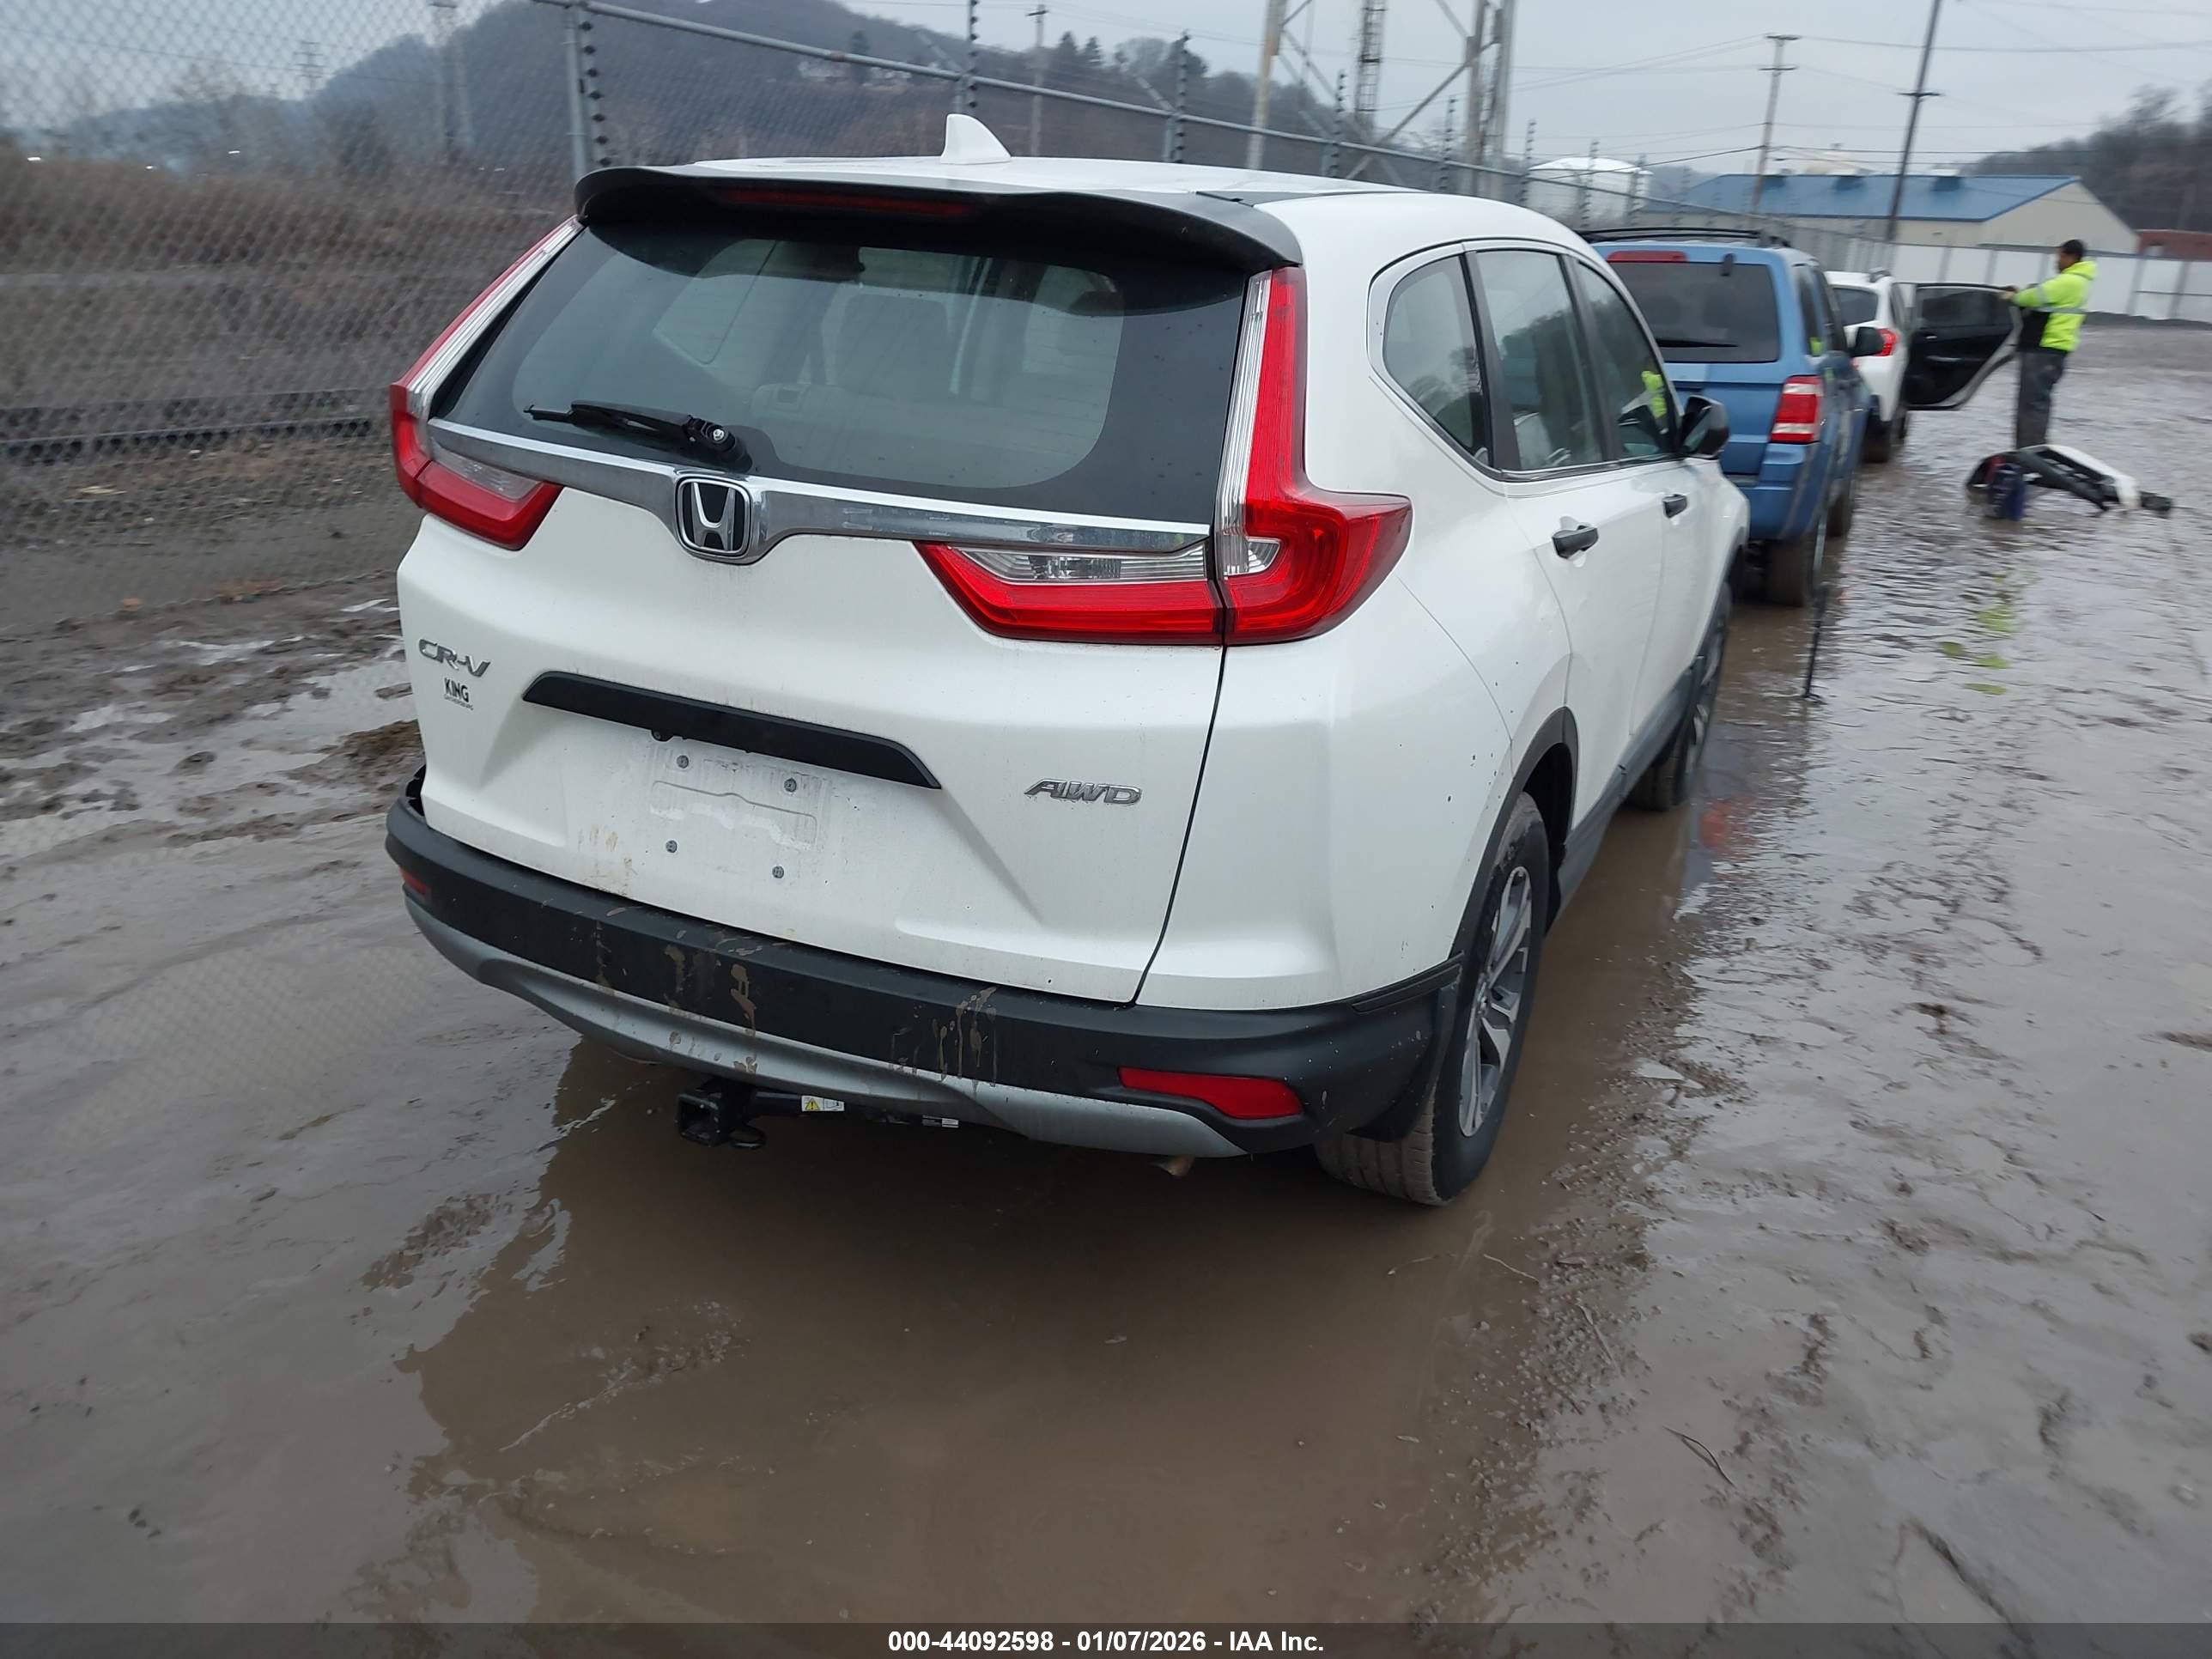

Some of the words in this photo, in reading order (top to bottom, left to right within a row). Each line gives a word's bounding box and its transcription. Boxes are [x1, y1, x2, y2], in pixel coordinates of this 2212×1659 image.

[418, 639, 491, 678] CR-V
[443, 677, 470, 702] KING
[1024, 778, 1141, 804] AWD
